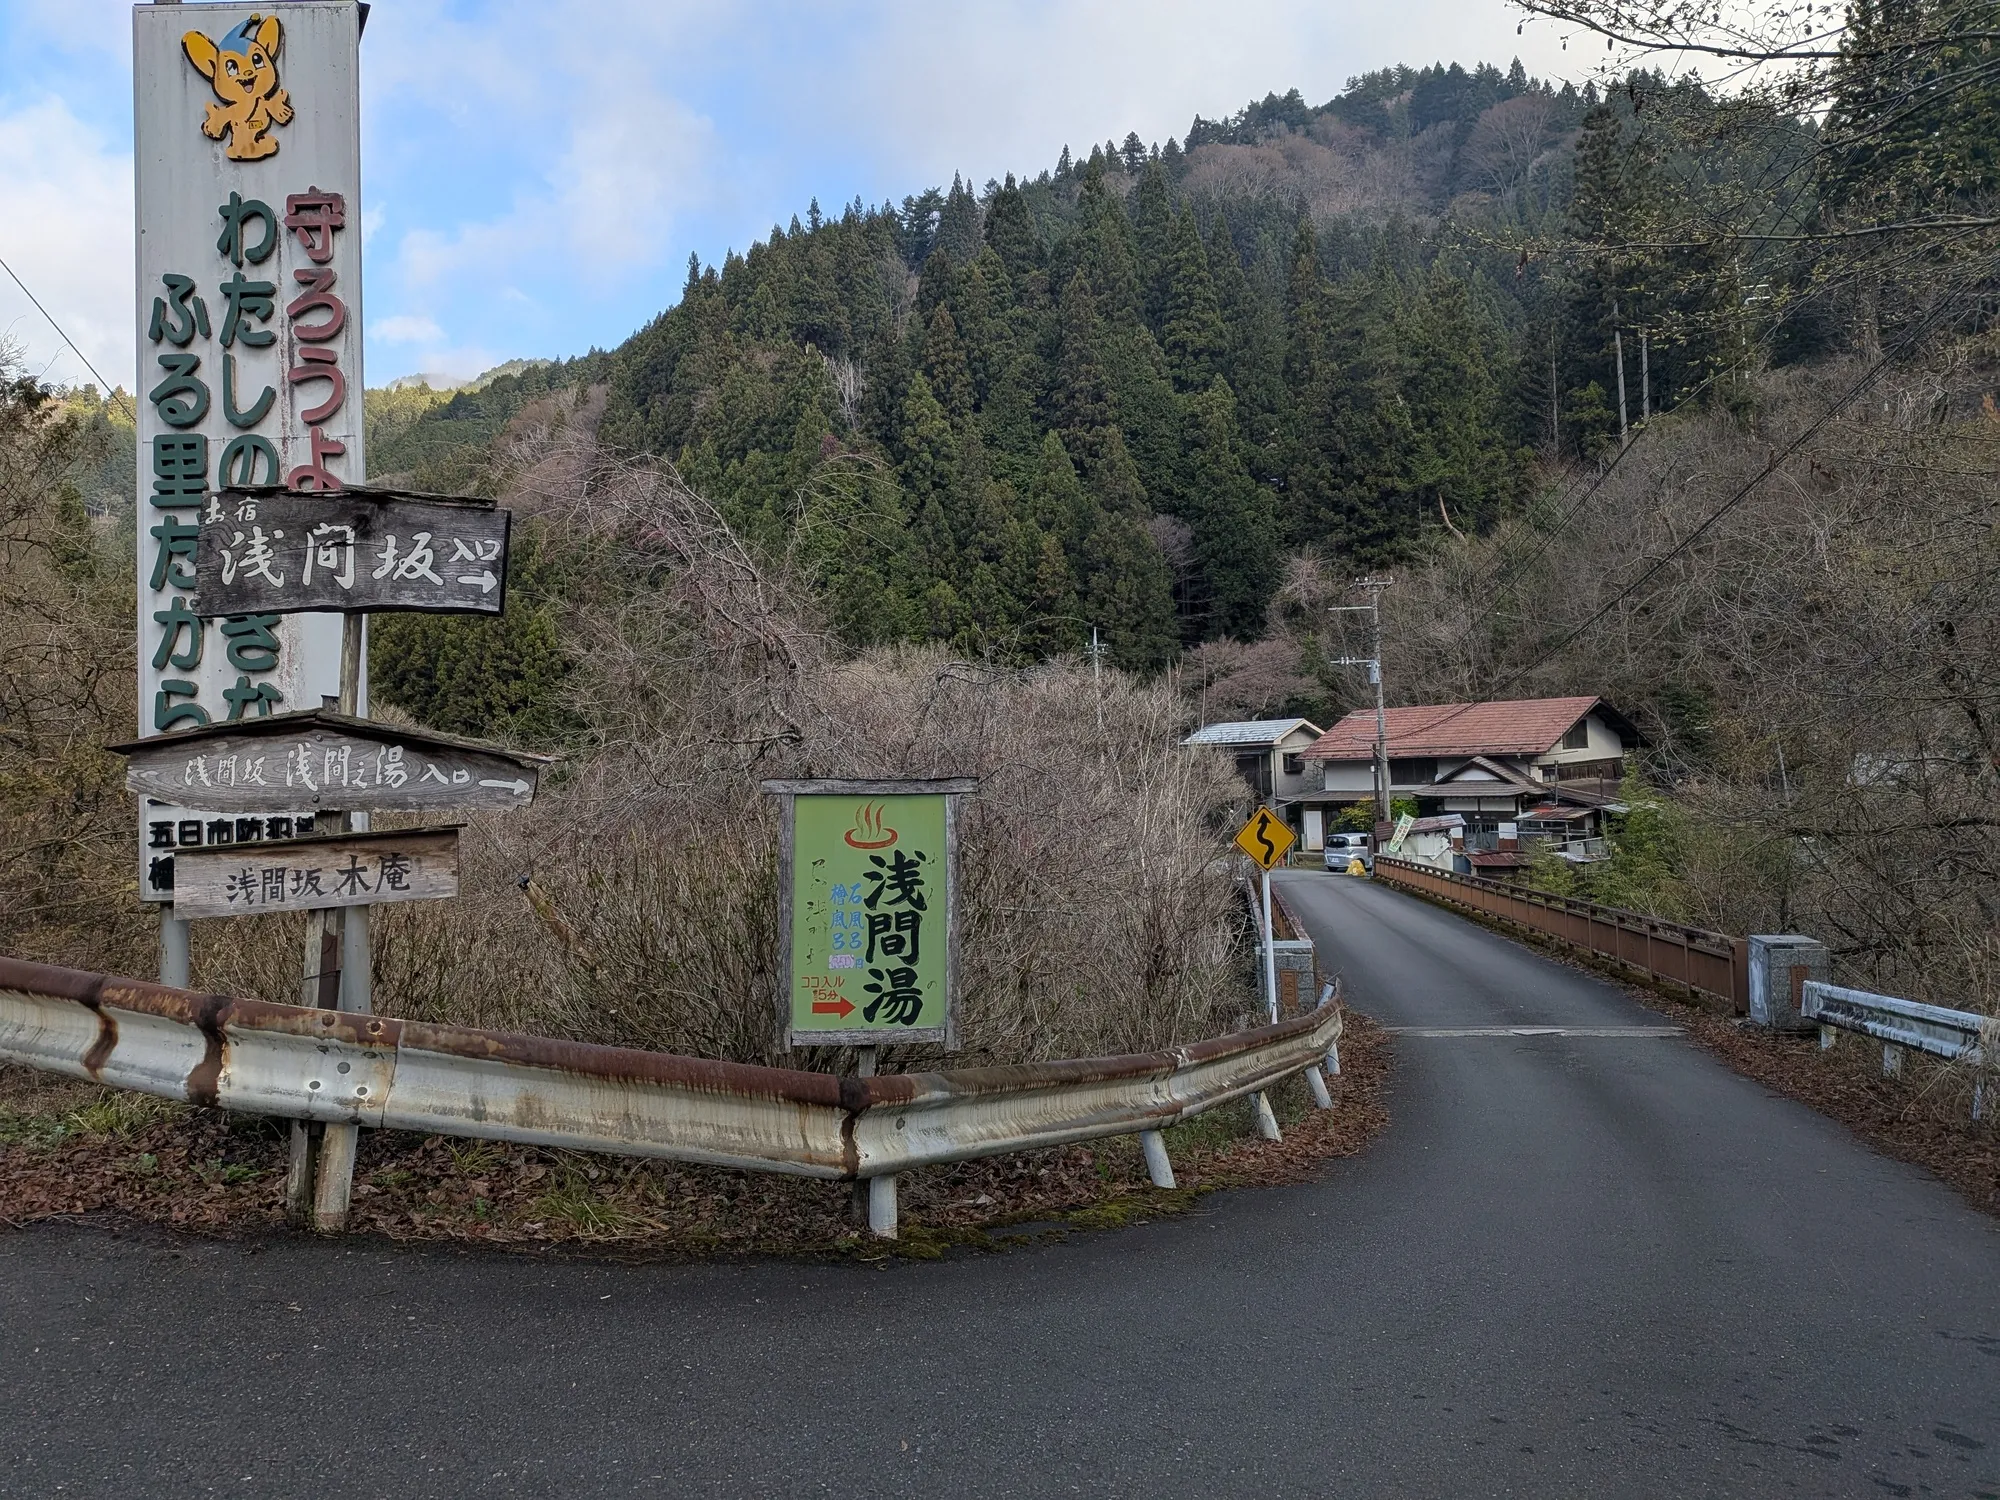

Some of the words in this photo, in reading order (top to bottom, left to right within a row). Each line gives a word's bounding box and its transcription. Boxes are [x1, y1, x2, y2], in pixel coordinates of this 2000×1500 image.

[284, 185, 345, 490] 守ろうよ
[217, 191, 283, 721] わたしのきな
[205, 496, 261, 525] お宿
[219, 522, 444, 590] 浅間坂
[448, 537, 502, 563] 入口
[184, 754, 267, 788] 浅間坂
[419, 763, 470, 785] 入口
[848, 882, 865, 950] 石風呂
[862, 849, 928, 1026] 浅間湯
[801, 976, 845, 989] ココ入ル
